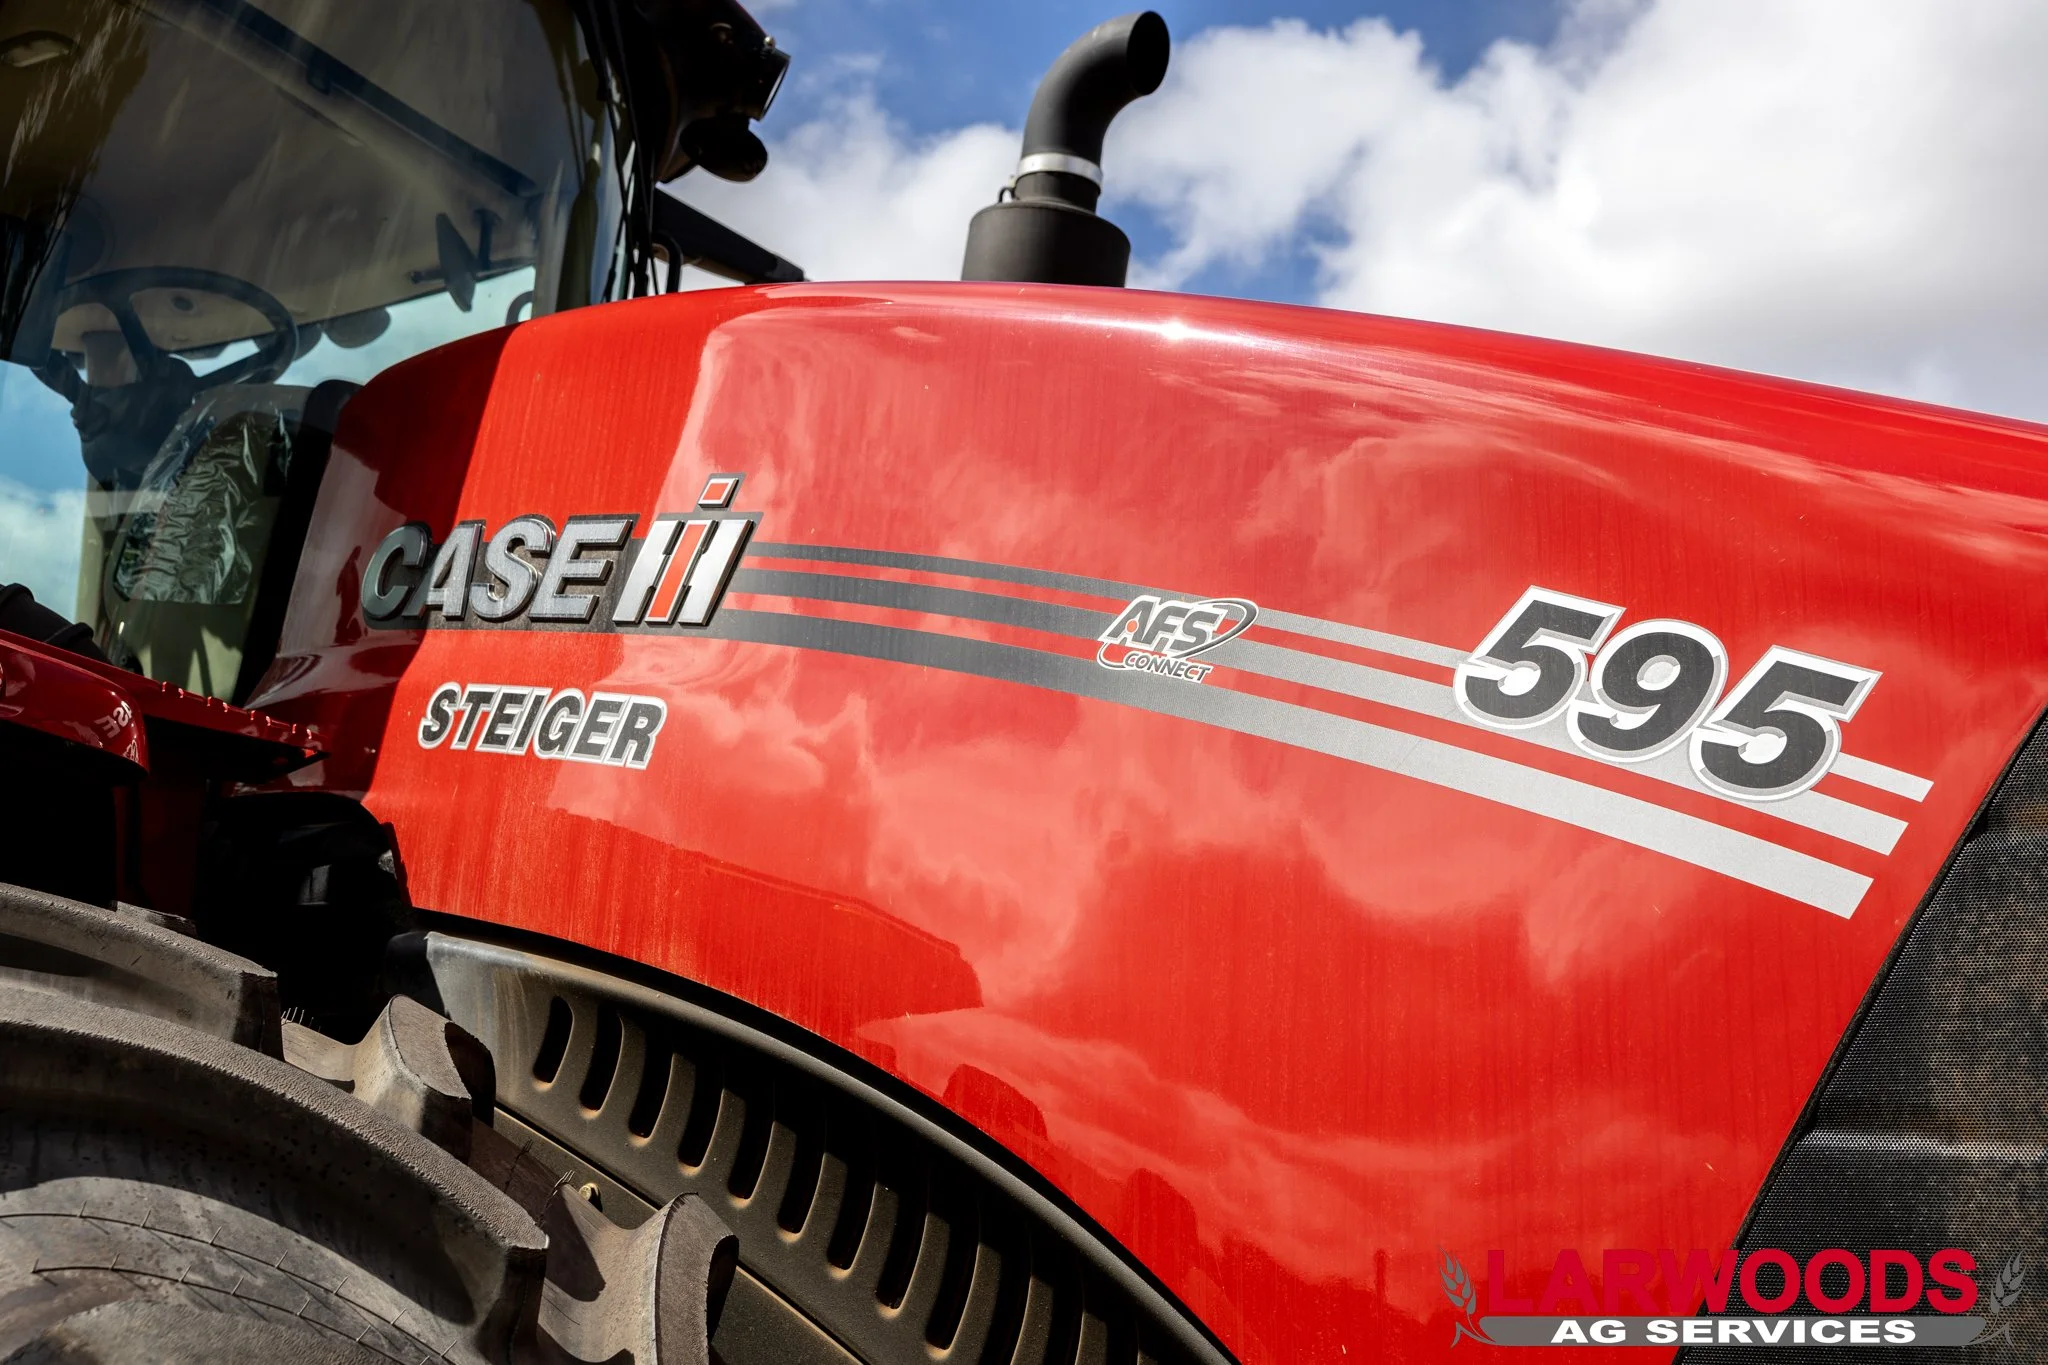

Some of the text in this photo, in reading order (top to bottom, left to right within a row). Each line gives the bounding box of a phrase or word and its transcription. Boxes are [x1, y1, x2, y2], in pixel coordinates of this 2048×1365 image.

[361, 516, 635, 623] CASE
[1098, 595, 1229, 653] AFS
[1124, 651, 1214, 683] CONNECT
[418, 683, 667, 769] STEIGER
[1453, 585, 1882, 803] 595
